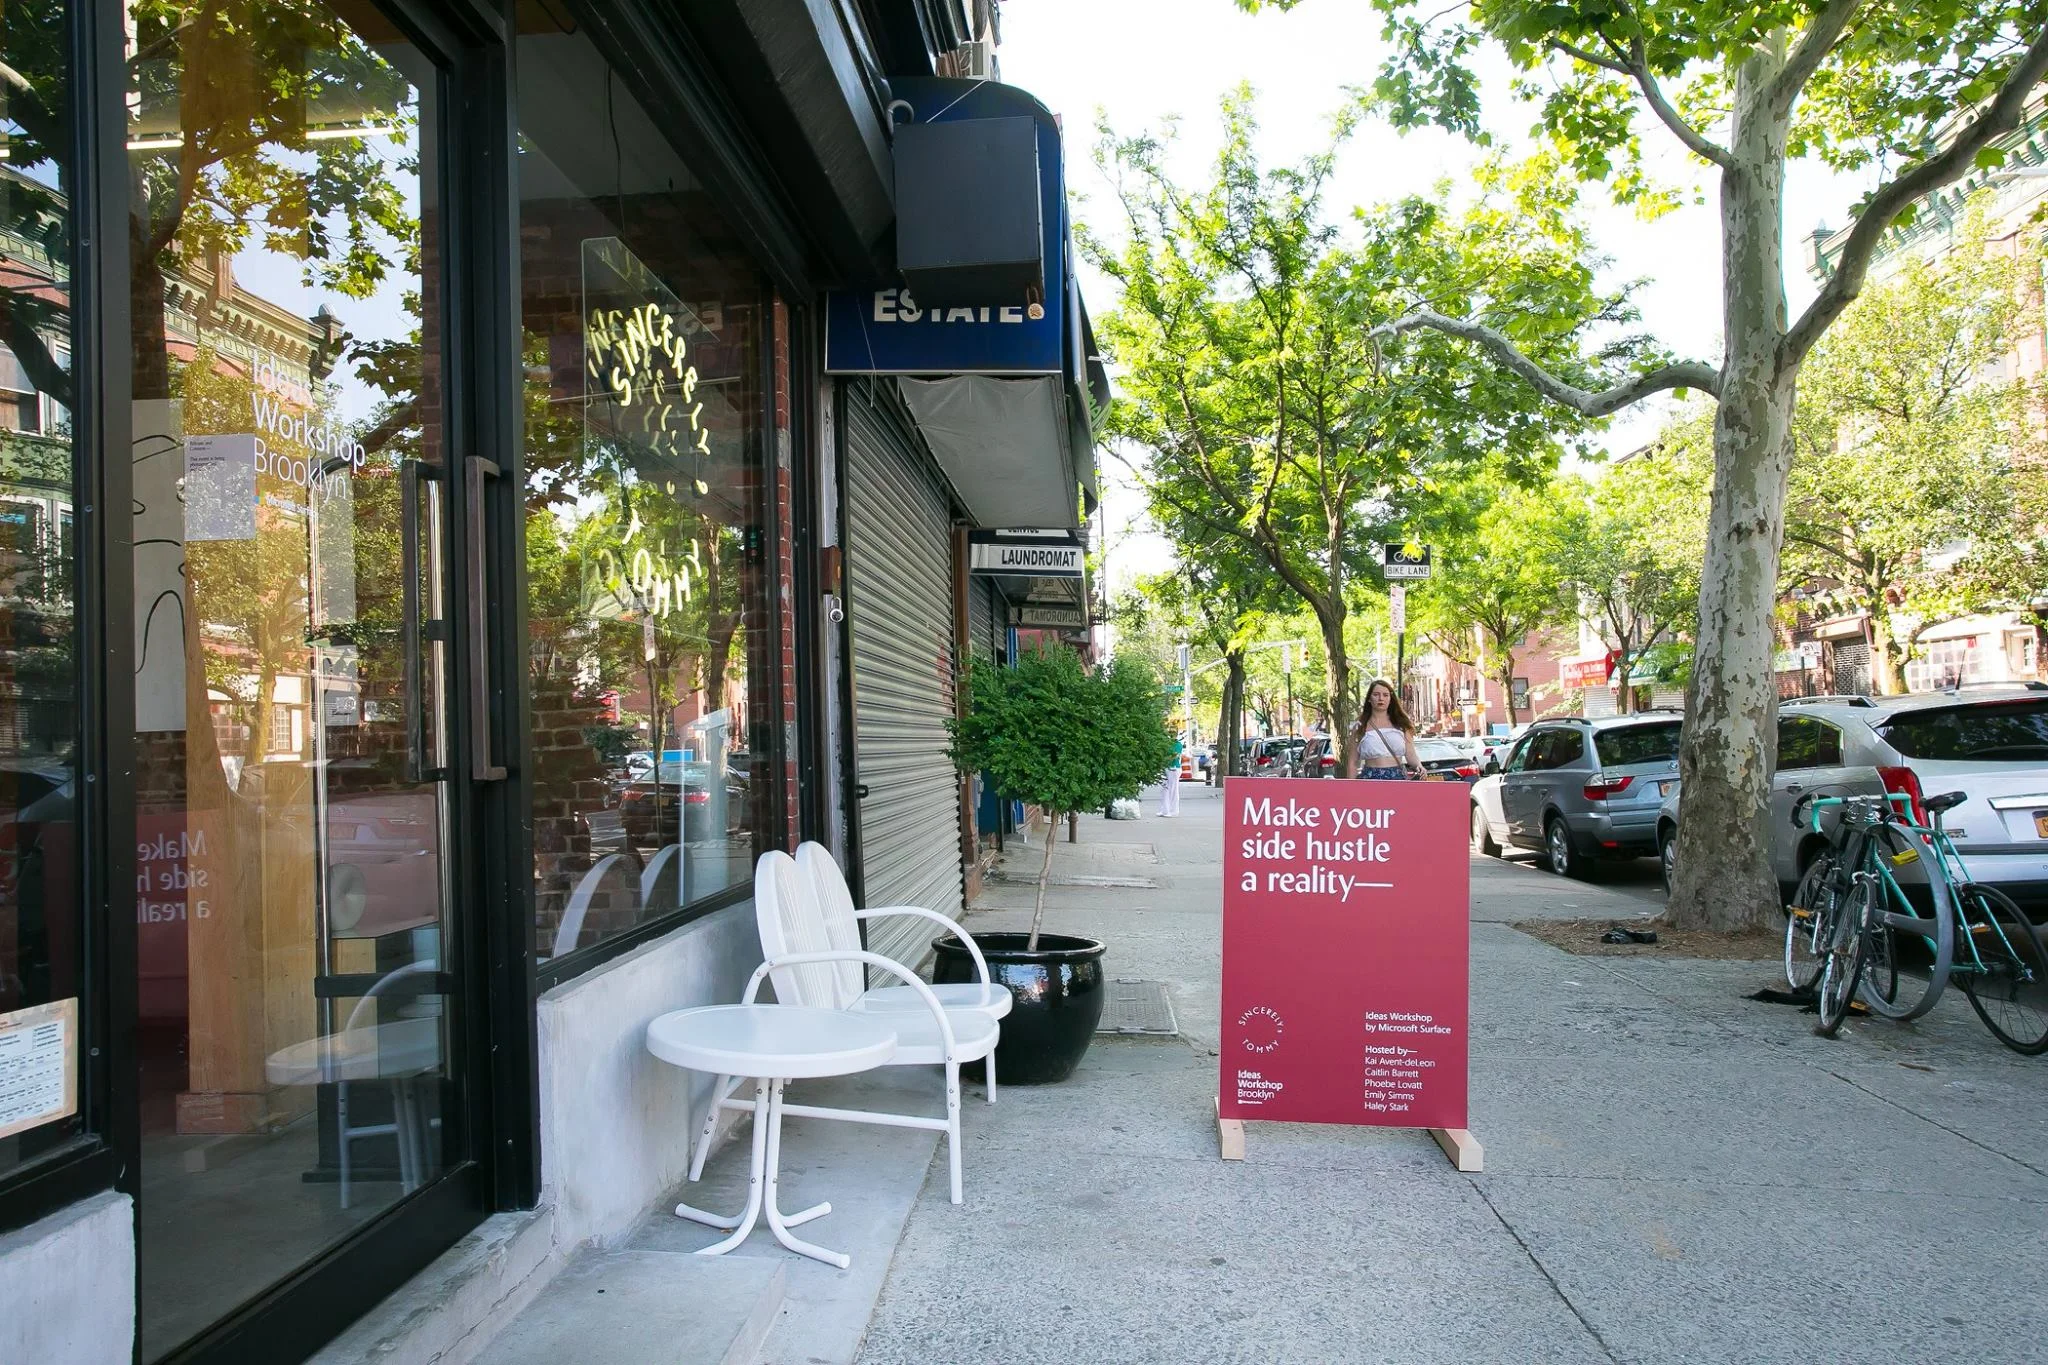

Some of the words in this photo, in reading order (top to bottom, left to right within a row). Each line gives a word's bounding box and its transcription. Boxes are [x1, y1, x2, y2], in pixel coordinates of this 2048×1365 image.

[252, 392, 366, 474] Workshop
[253, 437, 347, 503] Brooklyn
[1001, 549, 1077, 567] LAUNDROMAT
[1387, 566, 1404, 575] BIKE
[1408, 566, 1429, 575] LANE
[1242, 797, 1321, 828] Make
[1329, 807, 1396, 836] your
[1241, 831, 1296, 859] side
[1306, 832, 1391, 862] hustle
[1241, 871, 1257, 892] a
[1365, 1011, 1388, 1021] Ideas
[1389, 1012, 1433, 1023] Workshop
[1365, 1023, 1376, 1033] by
[1378, 1023, 1418, 1033] Microsoft
[1420, 1025, 1452, 1034] Surface
[1242, 1038, 1280, 1054] TOMMY
[1365, 1045, 1395, 1055] Hosted
[1365, 1056, 1377, 1065] Kai
[1238, 1070, 1262, 1079] Ideas
[1364, 1068, 1390, 1077] Caitlin
[1391, 1069, 1419, 1078] Barrett
[1238, 1079, 1284, 1092] Workshop
[1364, 1079, 1396, 1088] Phoebe
[1398, 1080, 1423, 1090] Lovatt
[1238, 1089, 1275, 1101] Brooklyn
[1364, 1090, 1386, 1101] Emily
[1388, 1091, 1415, 1101] Simms
[1364, 1102, 1388, 1112] Haley
[1389, 1103, 1409, 1111] Stark
